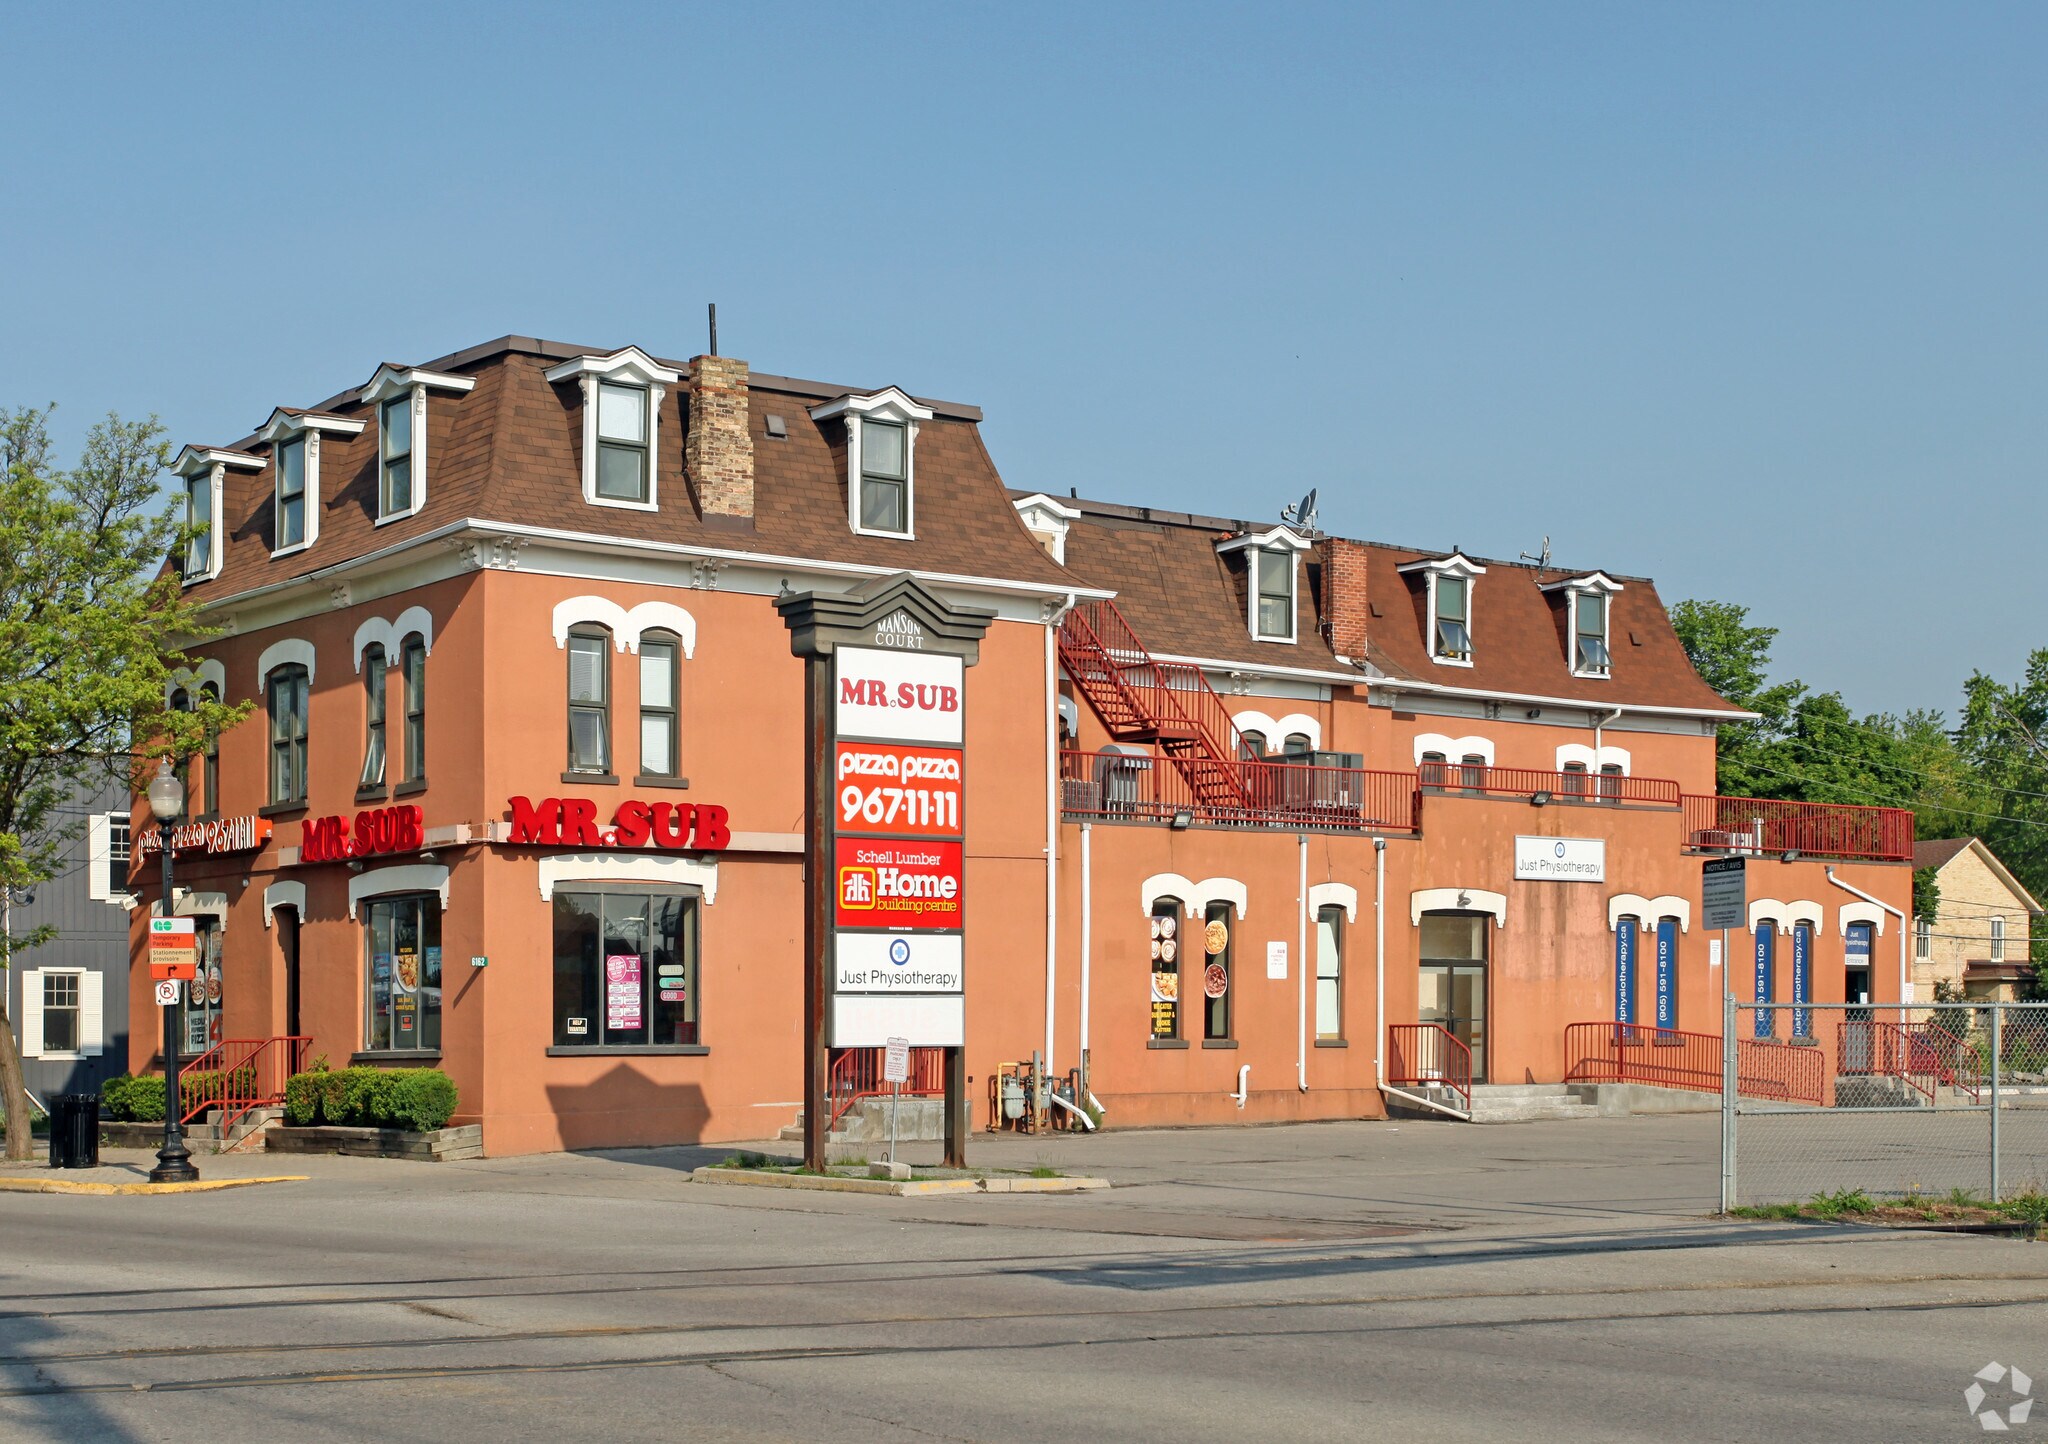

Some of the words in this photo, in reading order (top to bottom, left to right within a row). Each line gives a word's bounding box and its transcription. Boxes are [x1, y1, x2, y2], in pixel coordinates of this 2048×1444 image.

[877, 611, 921, 635] MANSON
[875, 632, 924, 649] COURT
[838, 752, 899, 781] pizza
[901, 755, 960, 785] pizza
[138, 829, 163, 863] pizz
[171, 822, 205, 858] pizza
[857, 850, 893, 864] Schell
[895, 851, 941, 866] Lumber
[1519, 859, 1537, 871] Just
[1540, 859, 1600, 875] Physiotherapy
[1705, 863, 1726, 872] NOTICE
[1729, 861, 1742, 869] AVIS
[876, 867, 958, 899] Home
[877, 897, 923, 914] building
[924, 898, 957, 912] centre
[1845, 939, 1868, 947] hysiotherapy
[471, 957, 485, 966] 6162
[1659, 941, 1667, 992] 591-8100
[1757, 943, 1765, 993] 591-8100
[840, 970, 867, 984] Just
[871, 970, 958, 988] Physiotherapy
[1619, 926, 1628, 1035] utphysiotherapy.ca
[1659, 995, 1668, 1021] (905)
[191, 1033, 206, 1045] PIZZ
